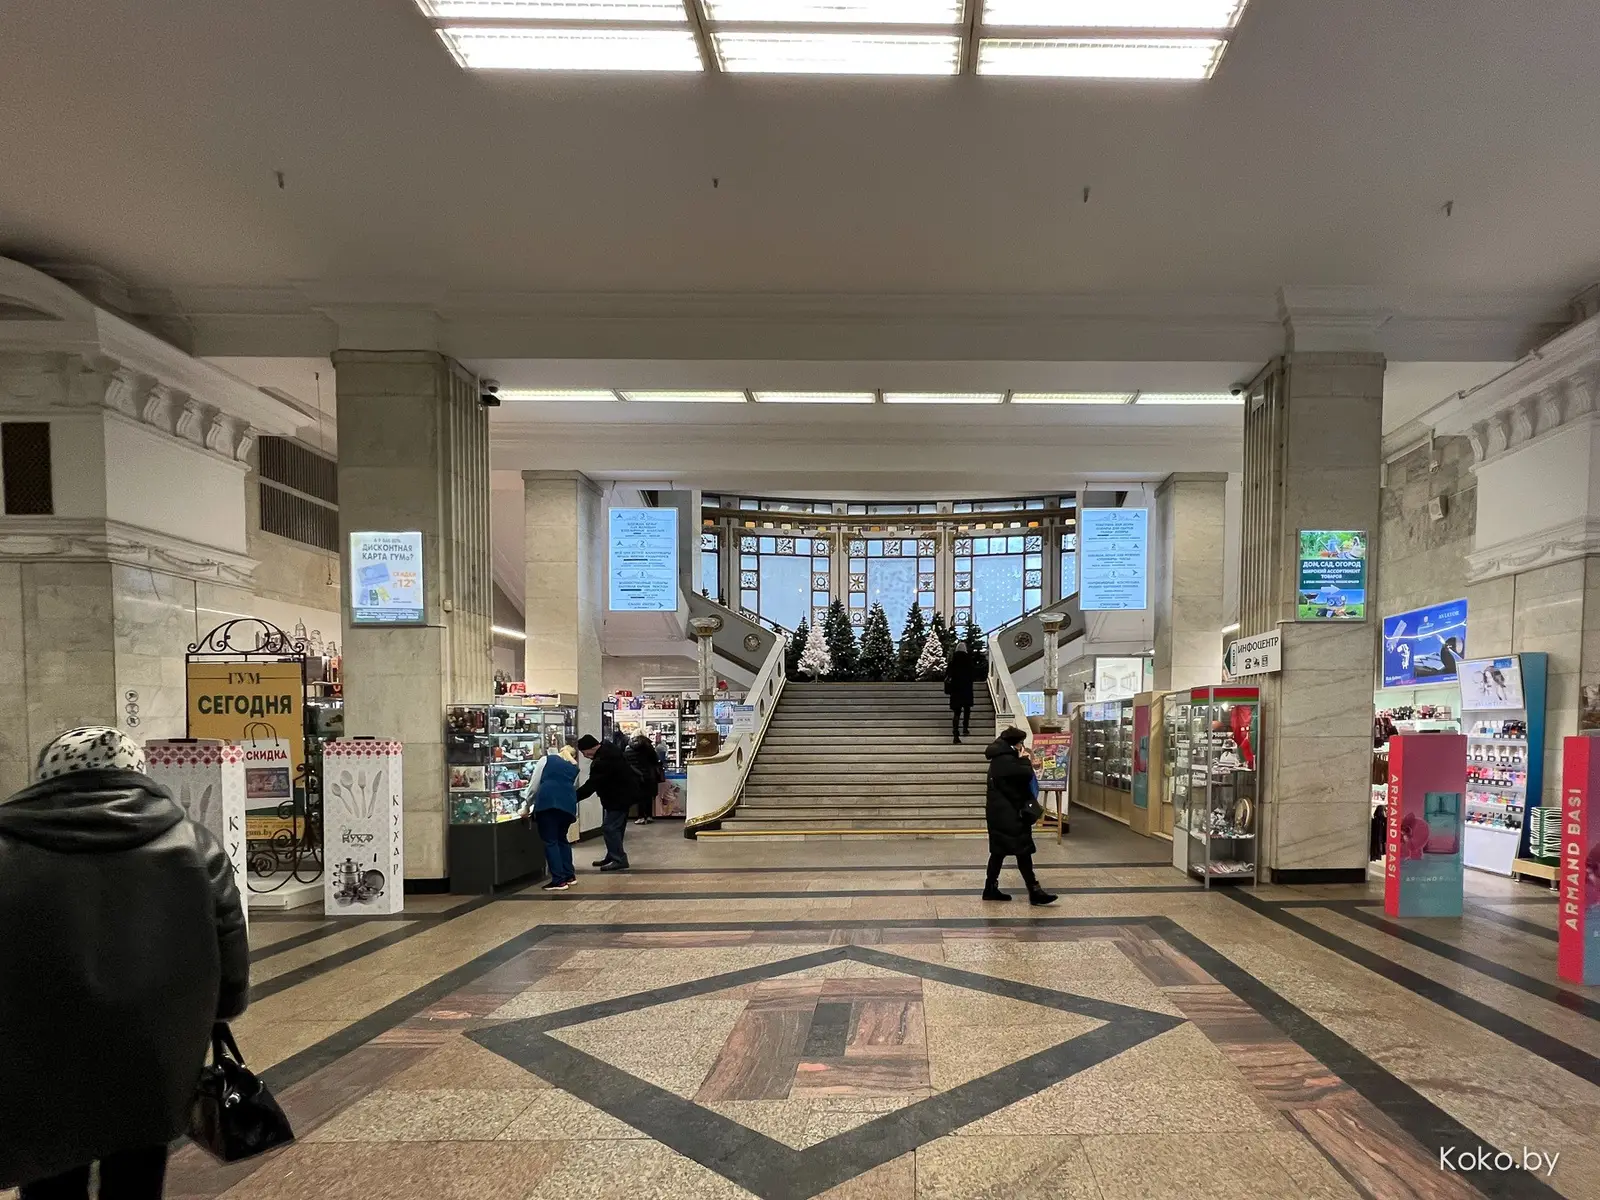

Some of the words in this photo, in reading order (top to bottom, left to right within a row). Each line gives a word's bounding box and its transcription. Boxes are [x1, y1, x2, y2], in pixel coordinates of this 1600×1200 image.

[362, 544, 413, 552] ДИСКОНТНАЯ
[362, 552, 387, 561] КАРТА
[1238, 636, 1279, 653] ИНФОЦЕНТР
[229, 672, 260, 684] ГУМ
[198, 695, 292, 718] СЕГОДНЯ
[246, 750, 287, 762] СКИДКА
[1388, 774, 1399, 839] ARMAND
[1568, 788, 1582, 836] BASI
[229, 815, 240, 874] КУХ
[392, 794, 400, 876] КУХАР
[1387, 843, 1397, 879] BASI
[1565, 842, 1580, 931] ARMAND
